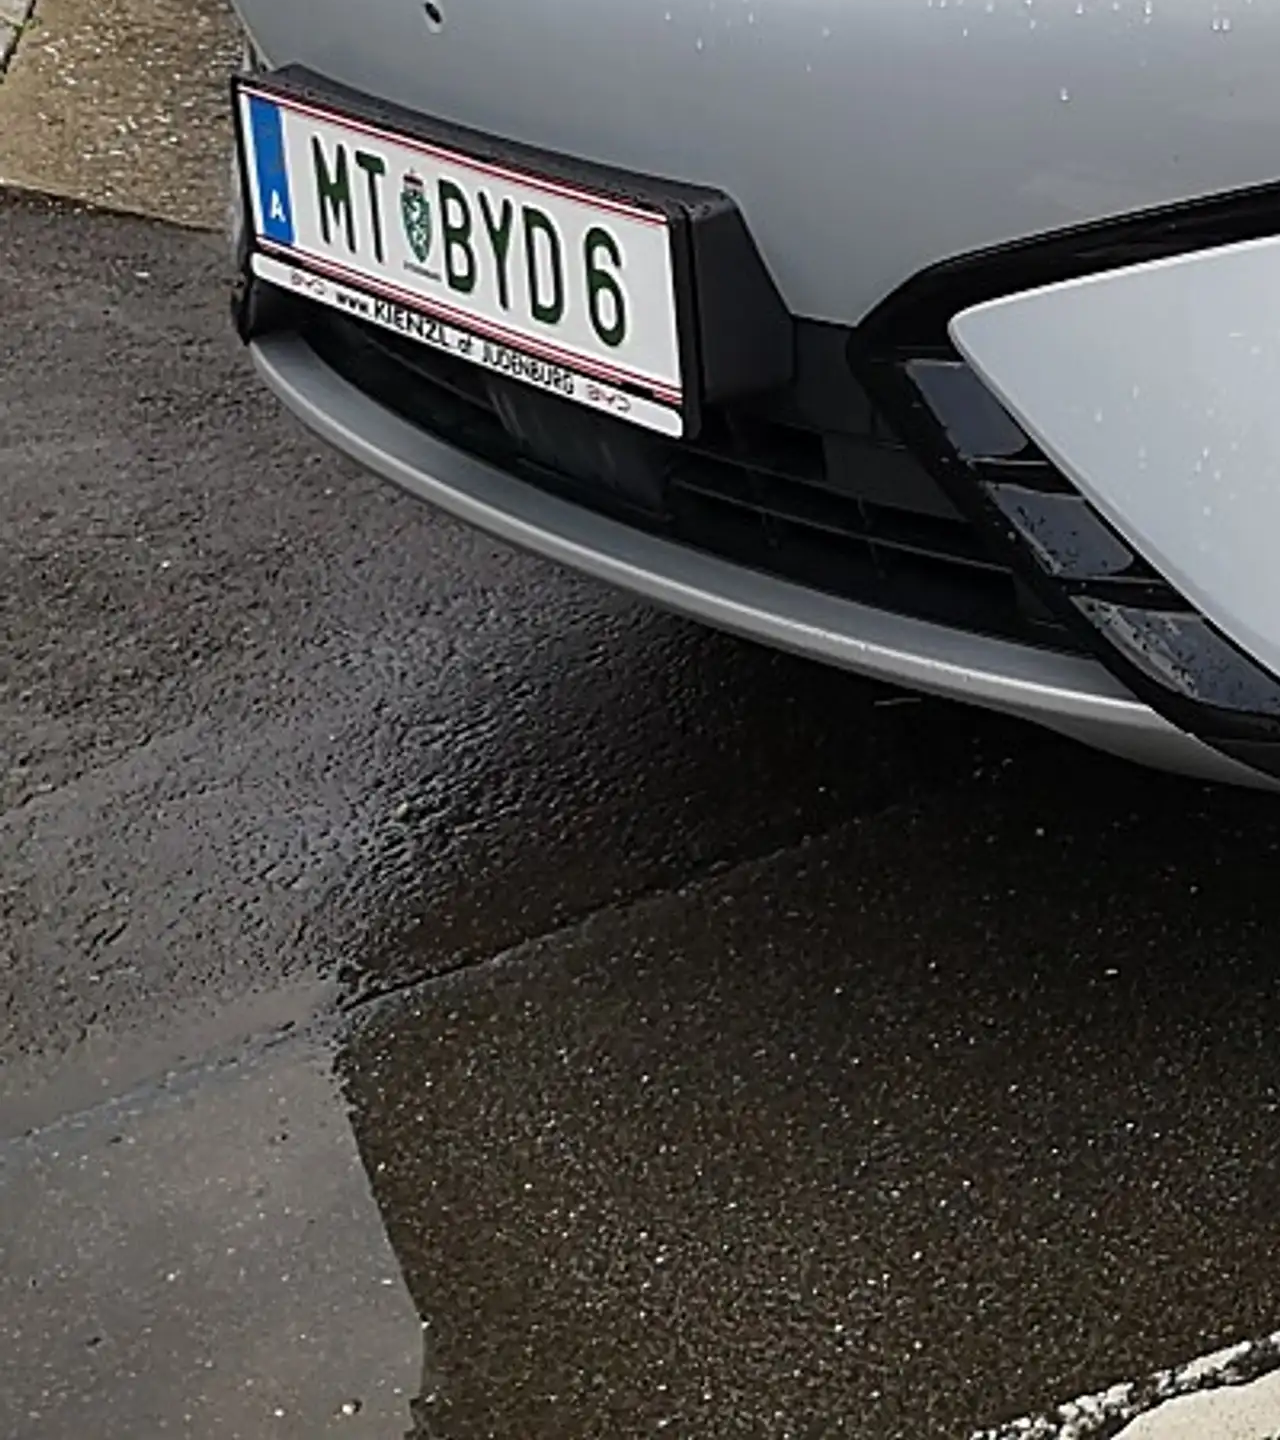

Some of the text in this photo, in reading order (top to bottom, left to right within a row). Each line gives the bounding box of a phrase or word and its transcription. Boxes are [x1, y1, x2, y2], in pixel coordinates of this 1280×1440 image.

[270, 188, 287, 224] A
[311, 135, 627, 348] MT BYD 6
[586, 383, 632, 413] BYD
